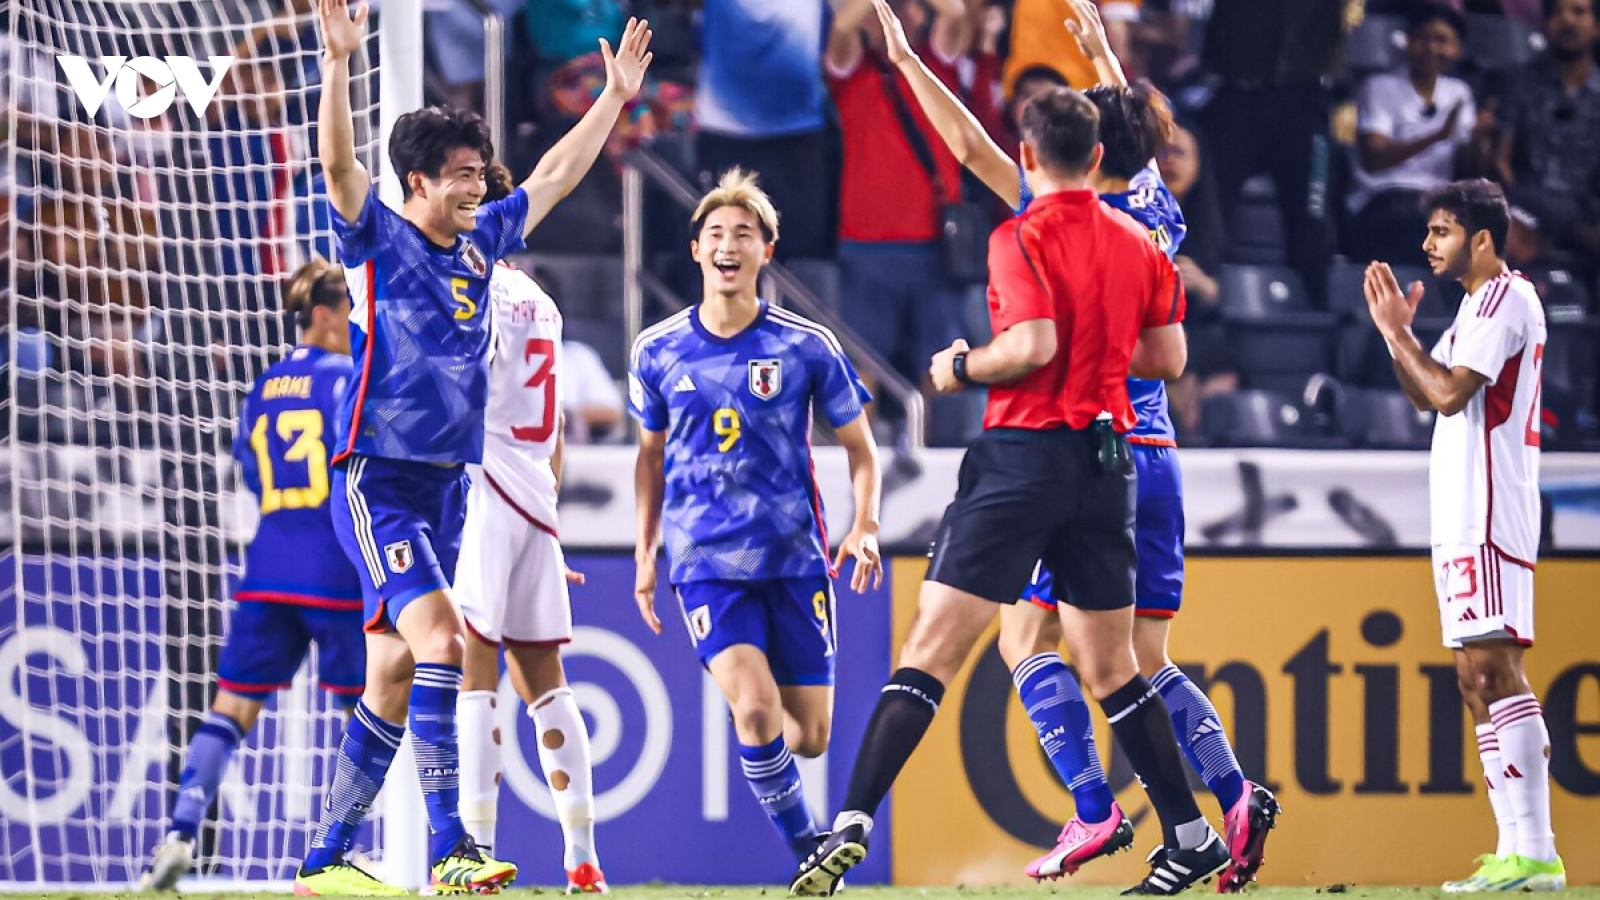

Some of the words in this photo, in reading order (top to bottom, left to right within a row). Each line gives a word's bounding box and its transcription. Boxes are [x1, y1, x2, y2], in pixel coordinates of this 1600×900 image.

[452, 278, 477, 319] 5
[511, 338, 556, 443] 3
[713, 408, 741, 453] 9
[252, 409, 329, 514] 13
[812, 590, 829, 637] 9
